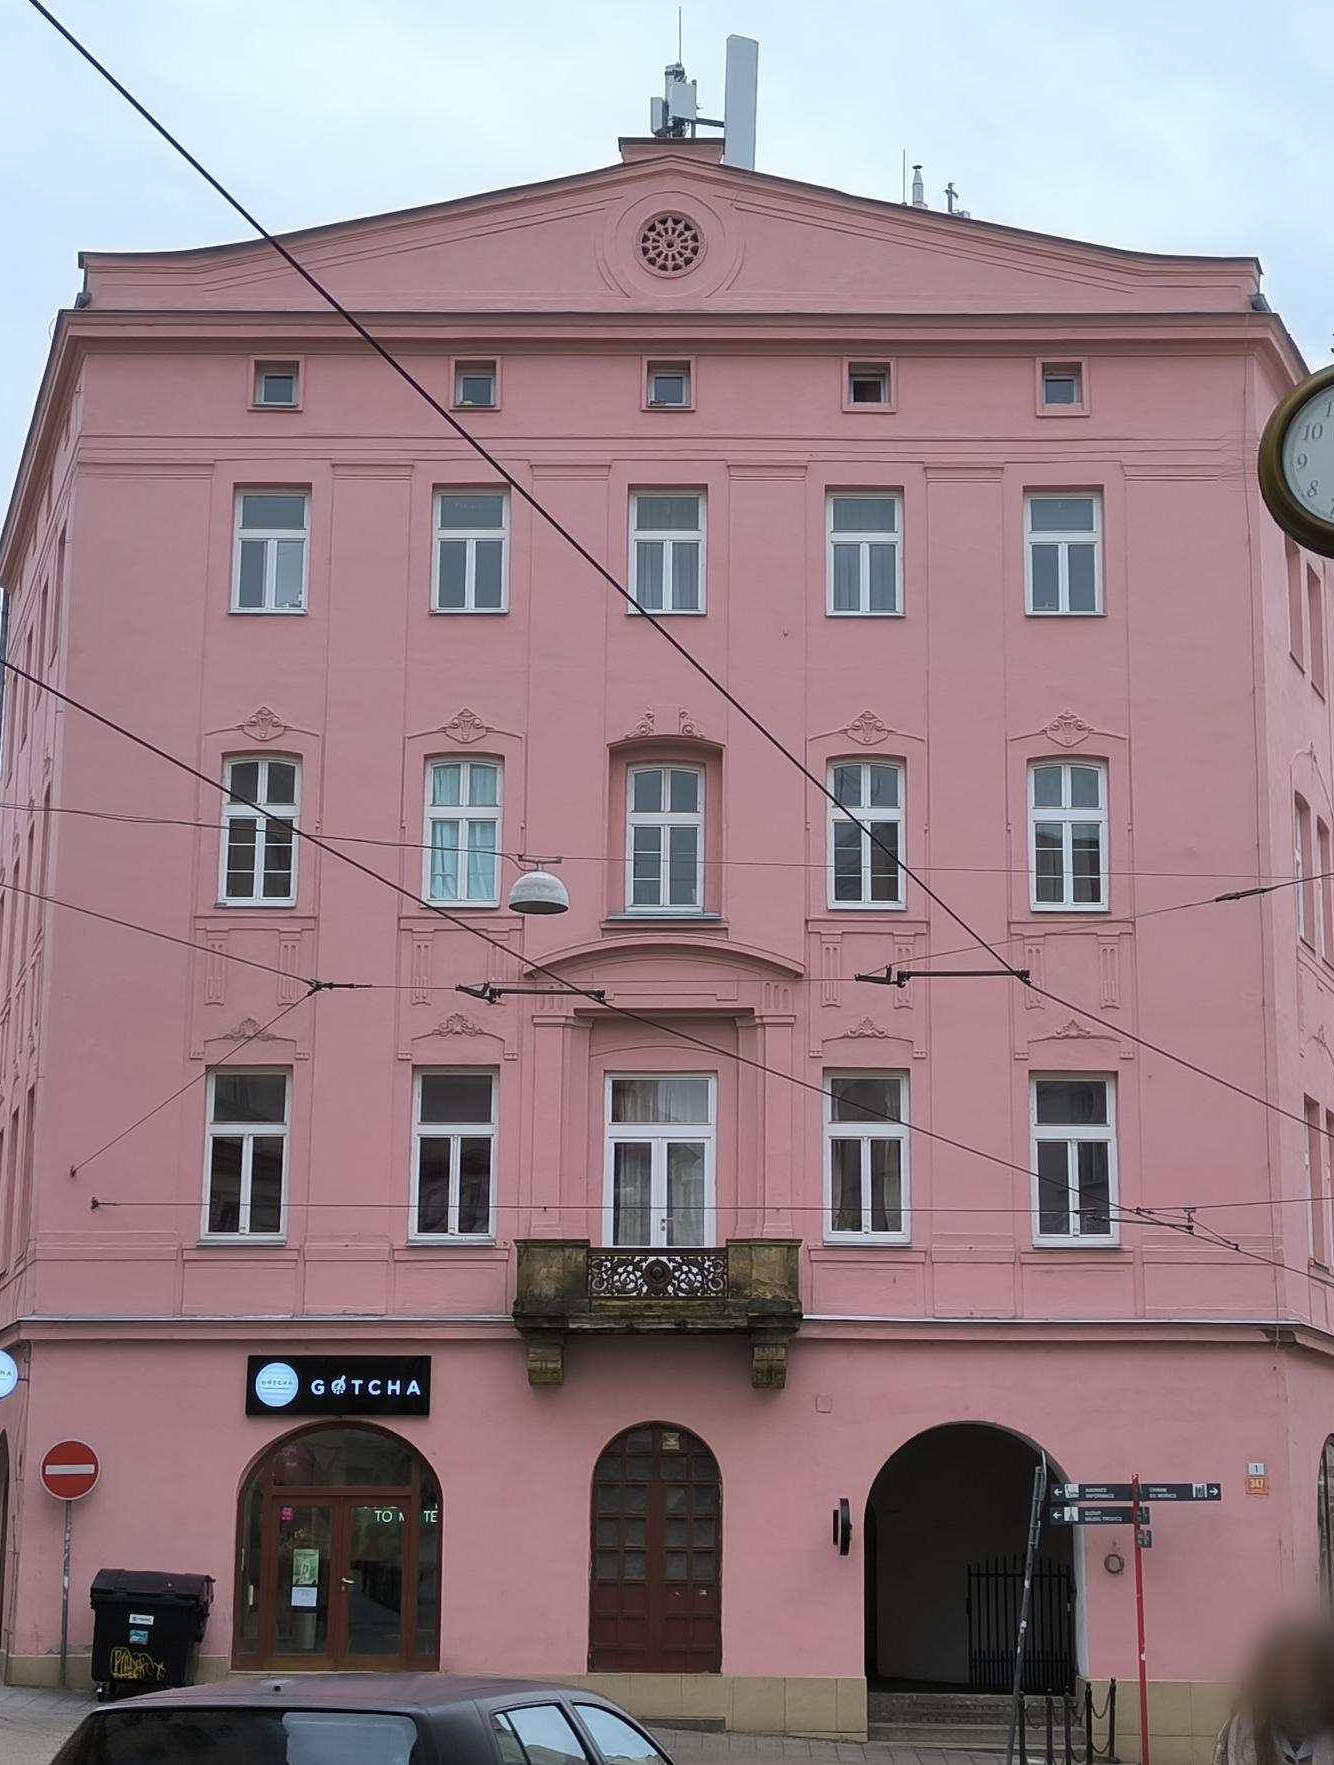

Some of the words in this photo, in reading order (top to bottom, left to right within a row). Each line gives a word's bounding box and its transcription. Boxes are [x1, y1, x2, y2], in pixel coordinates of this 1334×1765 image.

[1302, 422, 1323, 441] 10
[1296, 453, 1308, 471] 9
[1307, 480, 1319, 497] 8
[310, 1376, 421, 1396] GOTCHA
